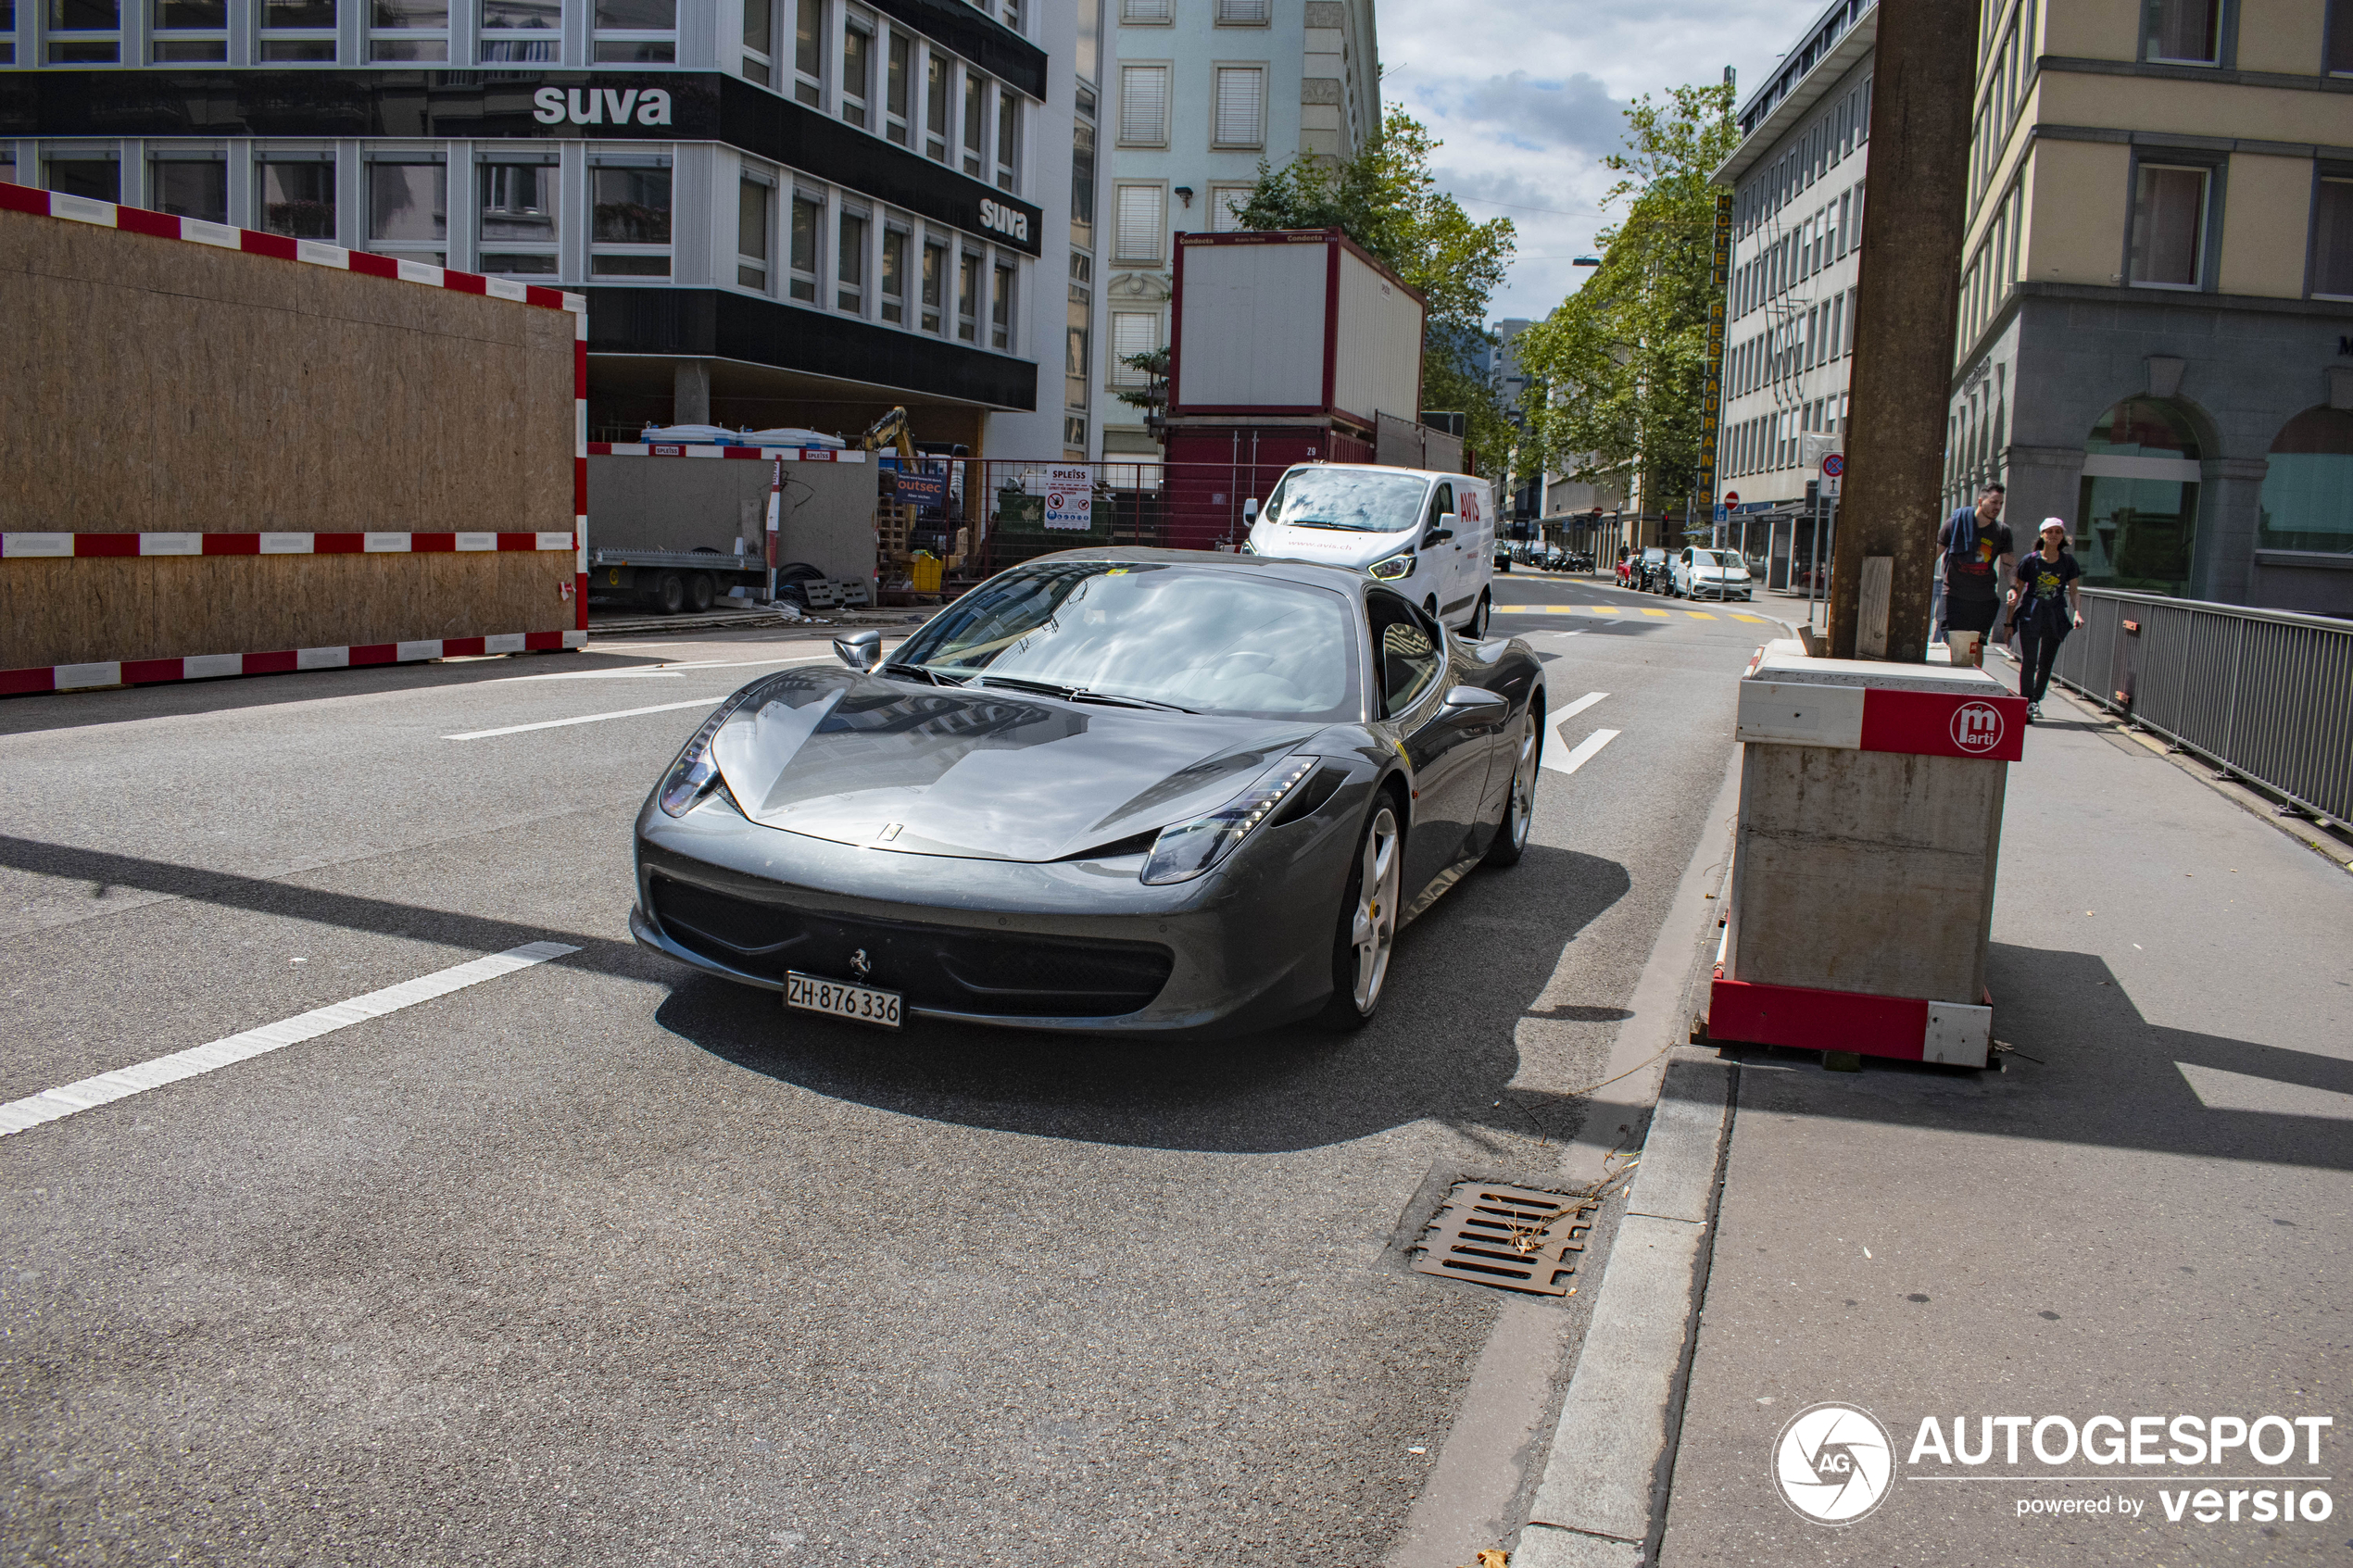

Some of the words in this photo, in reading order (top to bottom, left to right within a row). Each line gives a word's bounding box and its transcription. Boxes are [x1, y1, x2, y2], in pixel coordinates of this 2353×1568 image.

[533, 86, 673, 126] suva
[978, 196, 1028, 242] suva
[1715, 195, 1730, 284] HOTEL
[1701, 305, 1723, 504] RESTAURANTS
[898, 481, 940, 493] outsec
[1053, 469, 1086, 479] SPLEISS
[1460, 492, 1479, 523] AVIS
[1288, 540, 1353, 551] www.avis.ch
